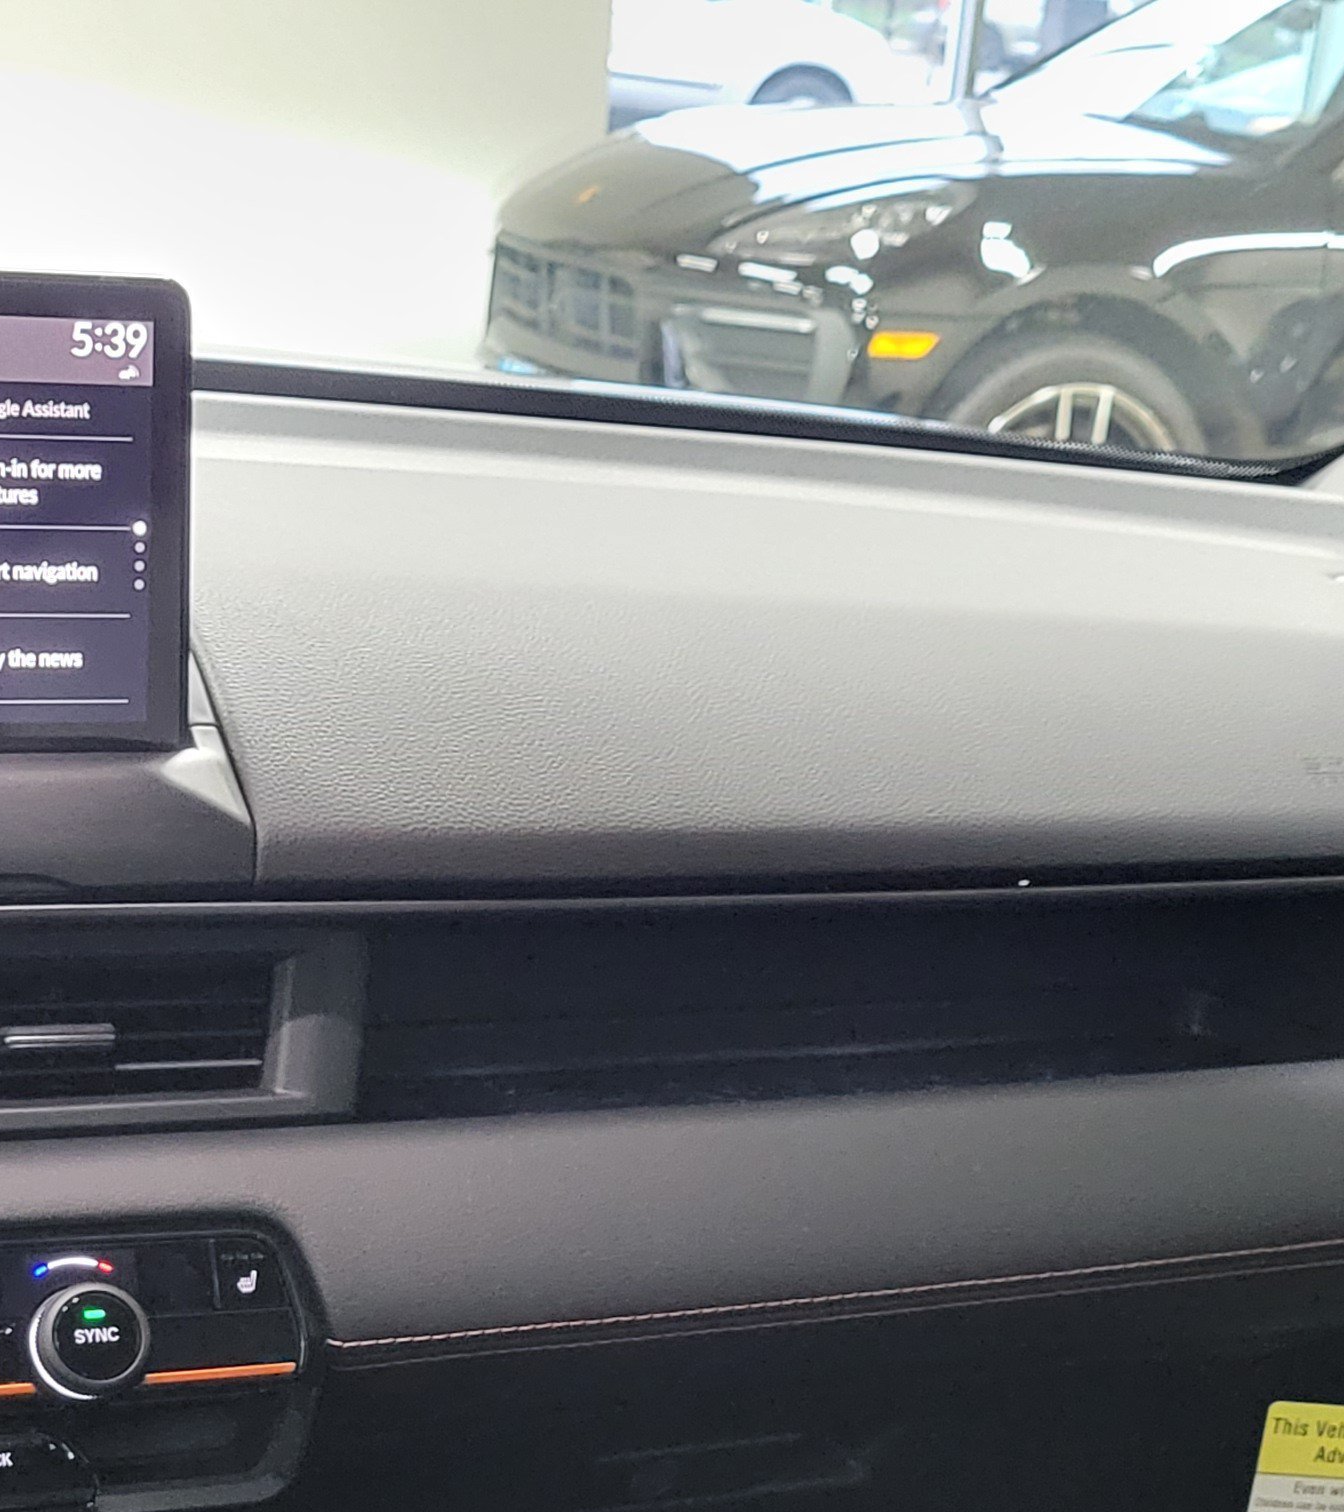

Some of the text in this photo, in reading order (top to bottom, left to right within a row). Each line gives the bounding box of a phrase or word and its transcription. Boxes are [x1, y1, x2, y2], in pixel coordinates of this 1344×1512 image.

[70, 320, 148, 359] 5:39
[22, 400, 91, 420] Assistant
[30, 459, 56, 479] for
[58, 463, 102, 481] more
[12, 562, 98, 586] navigation
[8, 650, 36, 668] the
[39, 652, 83, 669] news
[74, 1325, 120, 1345] SYNC
[1272, 1417, 1308, 1437] This
